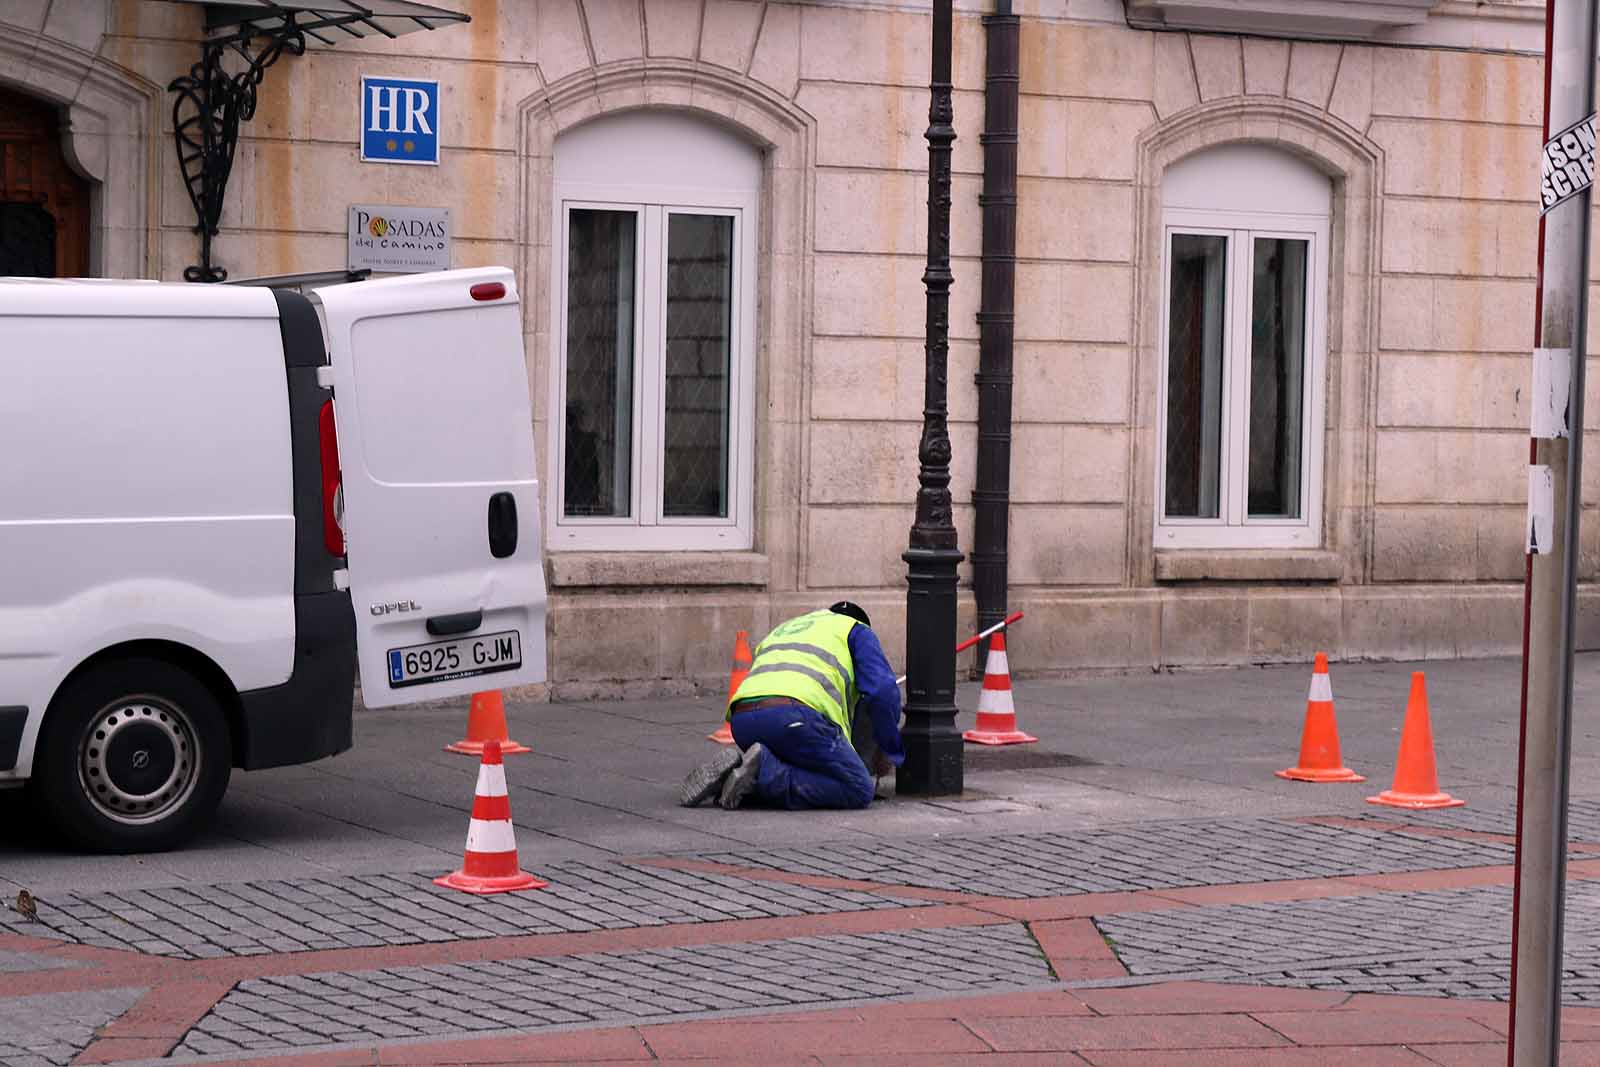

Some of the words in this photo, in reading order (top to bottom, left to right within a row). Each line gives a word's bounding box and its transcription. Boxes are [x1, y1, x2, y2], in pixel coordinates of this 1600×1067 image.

[367, 85, 433, 134] HR
[357, 211, 445, 238] POSADAS
[370, 599, 422, 616] OPEL
[405, 645, 460, 675] 6925
[473, 637, 513, 665] GJM
